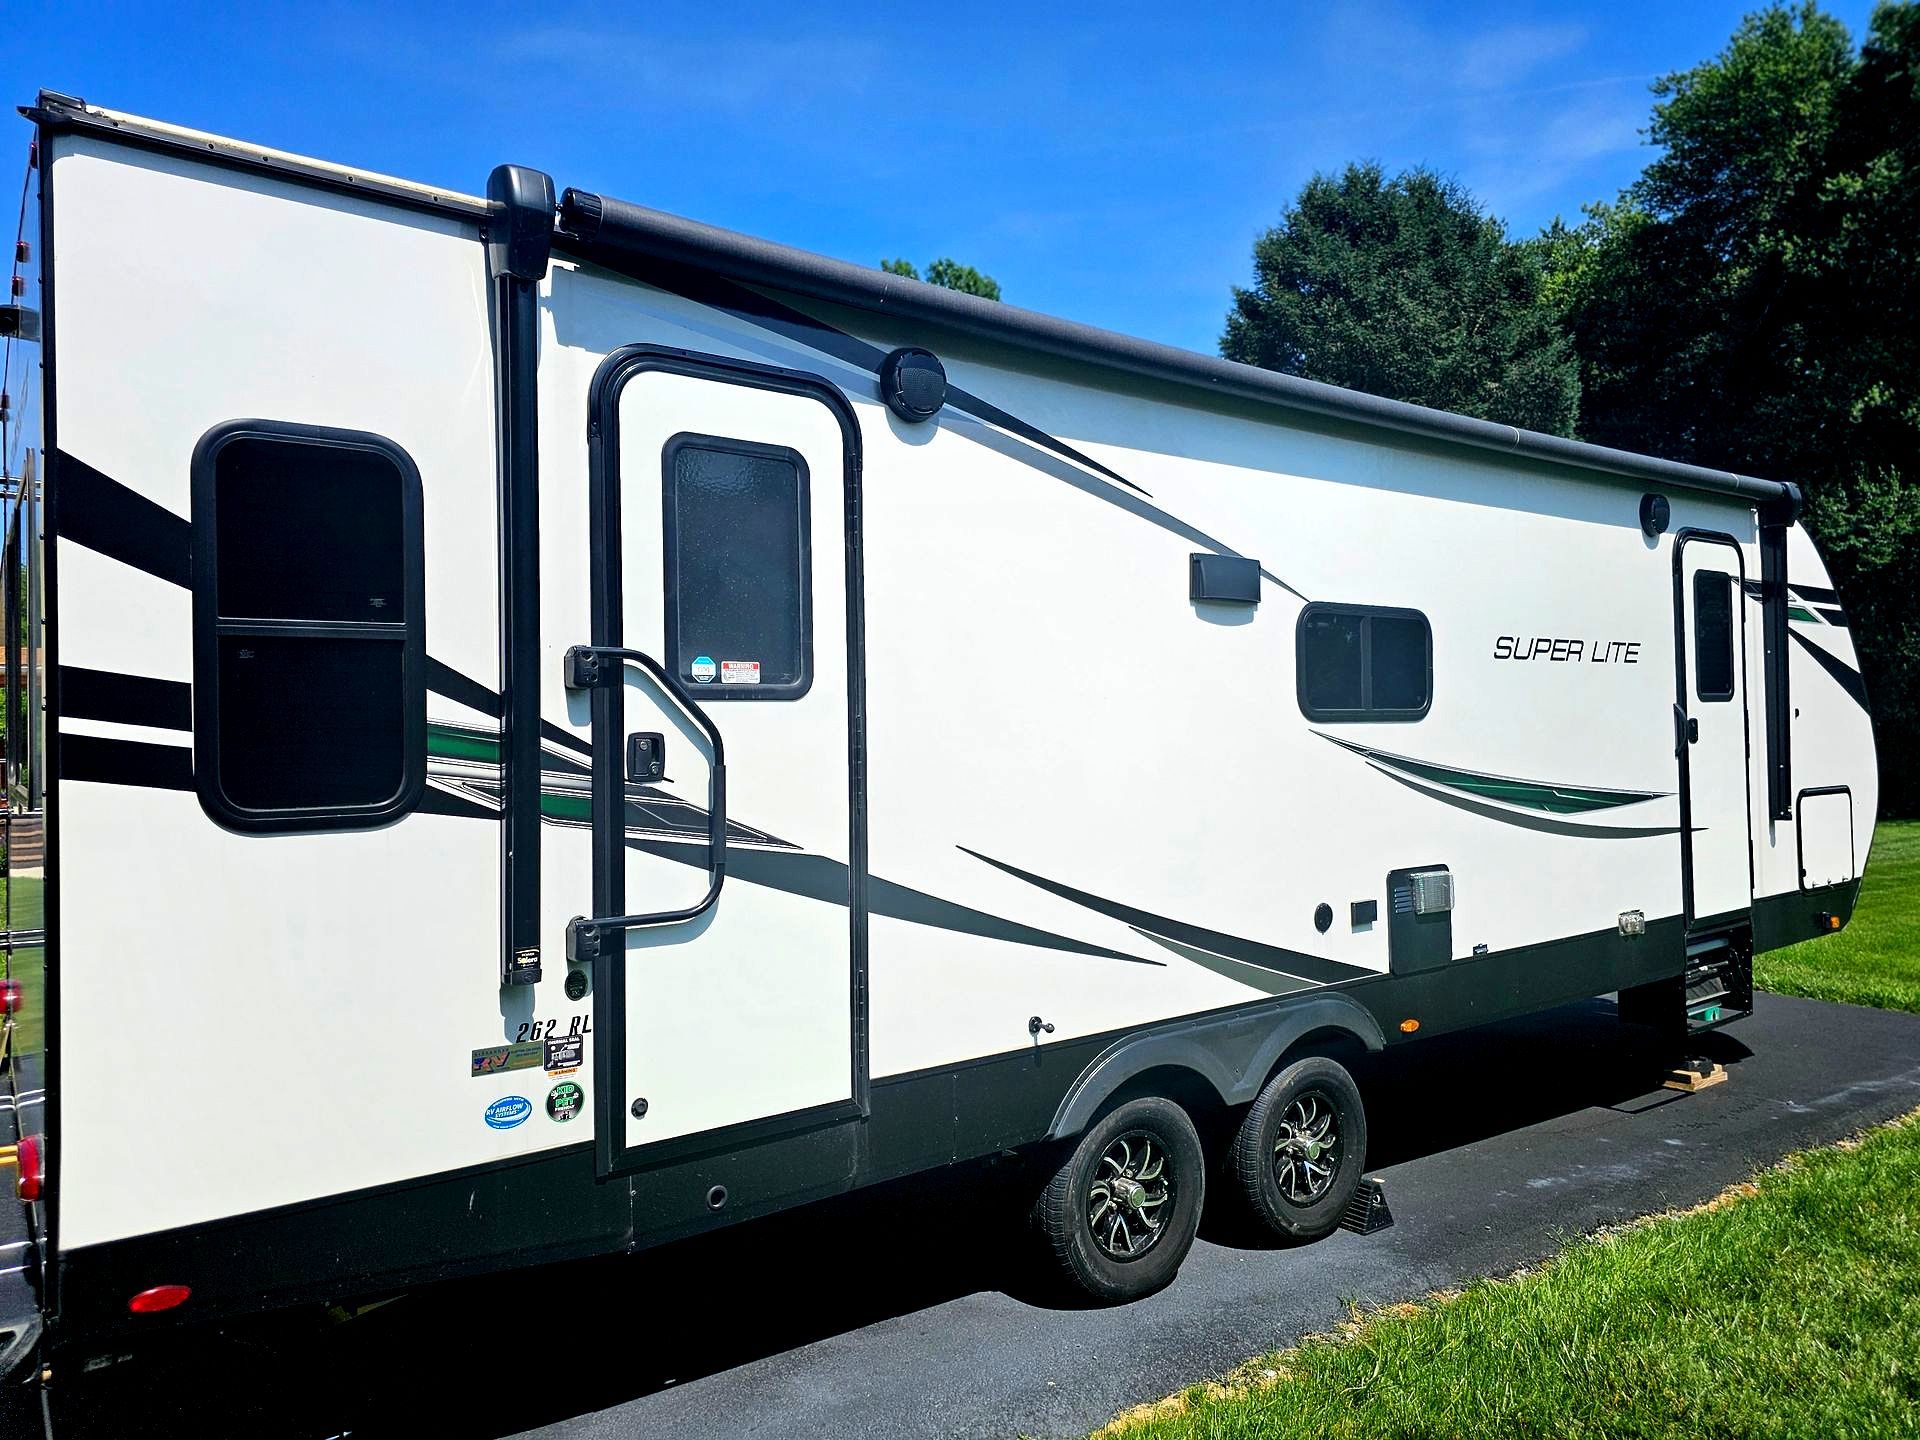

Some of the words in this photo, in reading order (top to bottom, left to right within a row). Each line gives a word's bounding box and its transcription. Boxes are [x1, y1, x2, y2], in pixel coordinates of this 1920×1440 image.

[1493, 636, 1585, 662] SUPER
[1591, 641, 1642, 664] LITE
[517, 956, 538, 964] Solera
[516, 1019, 557, 1044] 262
[569, 1015, 592, 1036] RL
[556, 1084, 575, 1095] KID
[495, 1102, 524, 1114] AIRFLOW
[555, 1097, 575, 1108] PET
